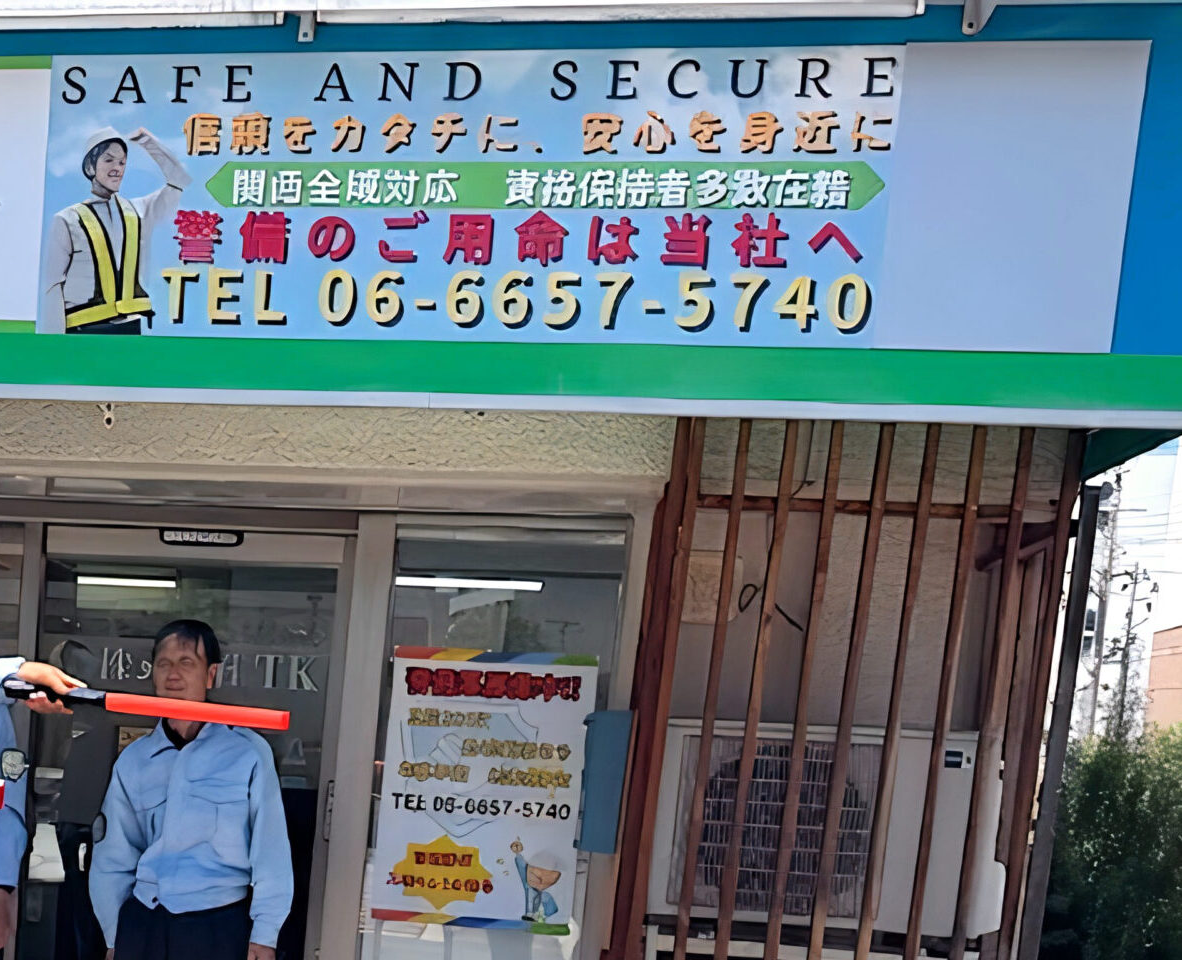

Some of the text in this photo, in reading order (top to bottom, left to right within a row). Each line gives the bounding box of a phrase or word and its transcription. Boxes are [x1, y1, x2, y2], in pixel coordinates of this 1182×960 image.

[61, 57, 898, 104] SAFE AND SECURE
[231, 168, 853, 209] 関西全域対応 資格保持者多数在籍
[161, 266, 874, 335] TEL 06-6657-5740
[255, 653, 318, 692] TK
[391, 792, 427, 813] TEL
